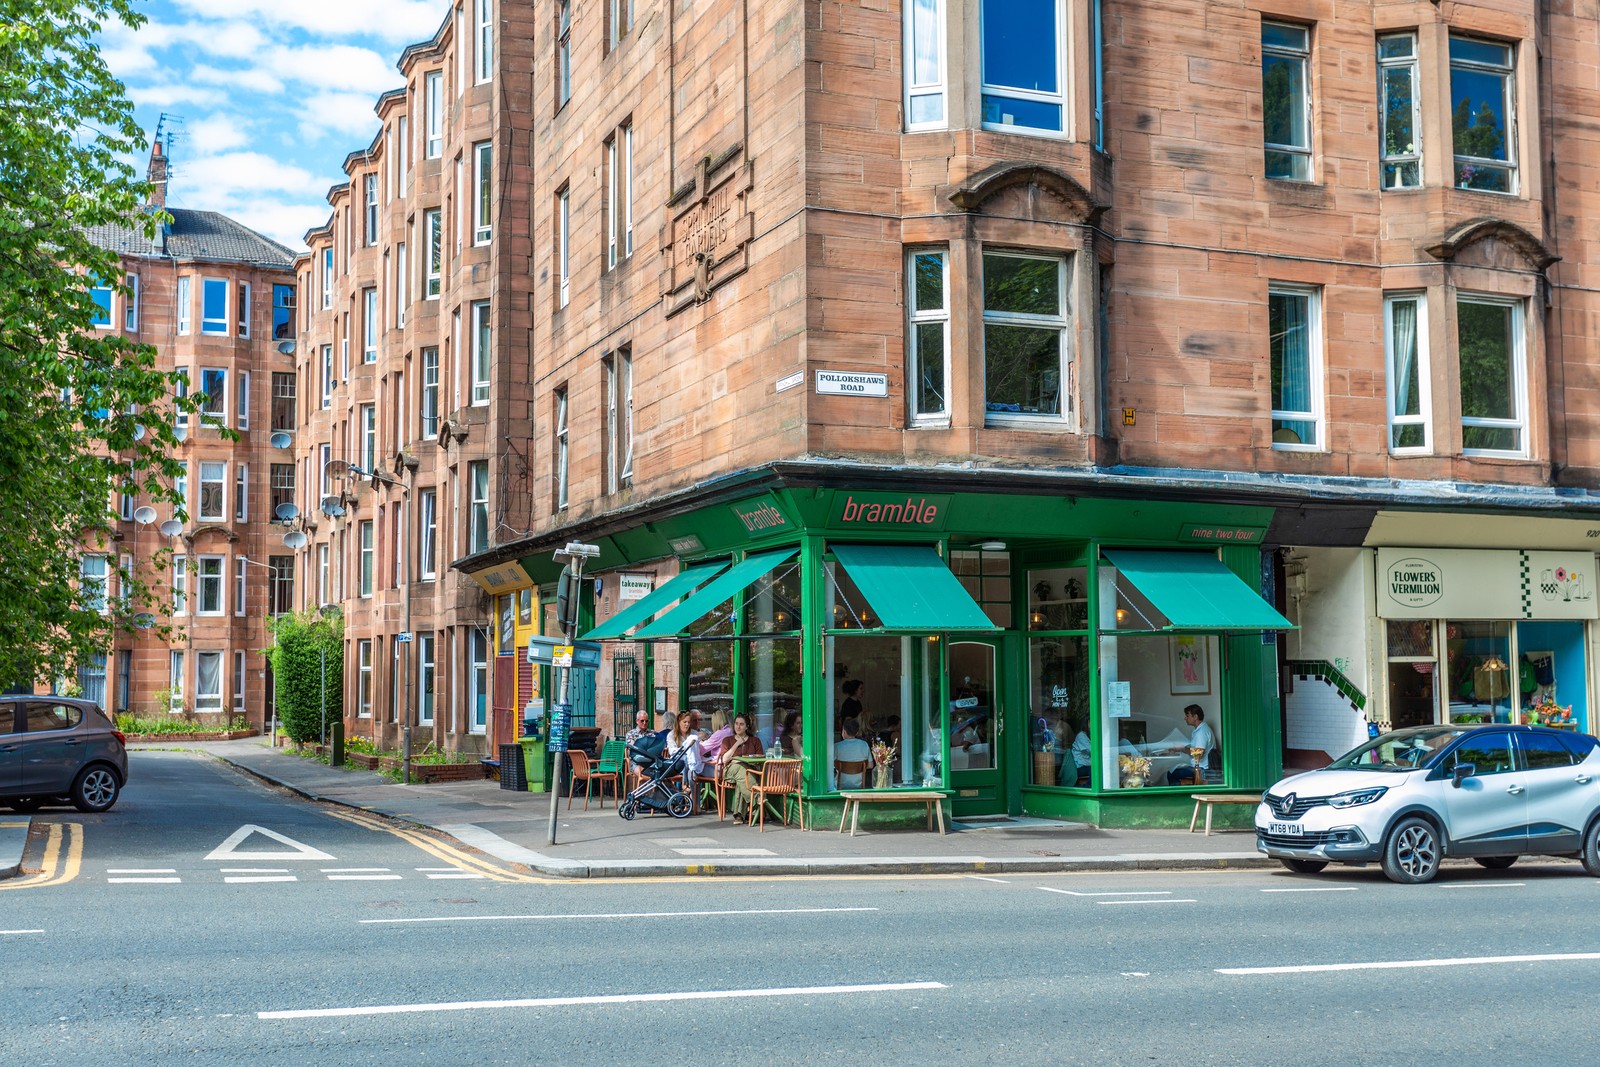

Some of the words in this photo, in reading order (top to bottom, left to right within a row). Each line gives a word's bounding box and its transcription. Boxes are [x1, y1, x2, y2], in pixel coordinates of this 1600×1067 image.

[820, 374, 885, 385] POLLOKSHAWS
[840, 384, 865, 392] ROAD
[842, 496, 938, 525] bramble
[739, 502, 786, 532] bramble
[1191, 528, 1212, 538] nine
[1215, 529, 1233, 539] two
[1234, 529, 1254, 540] four
[1394, 571, 1436, 582] FLOWERS
[621, 580, 650, 590] takeaway
[1391, 583, 1440, 595] VERMILION
[1270, 823, 1287, 833] MT68
[1287, 824, 1301, 834] YDA
